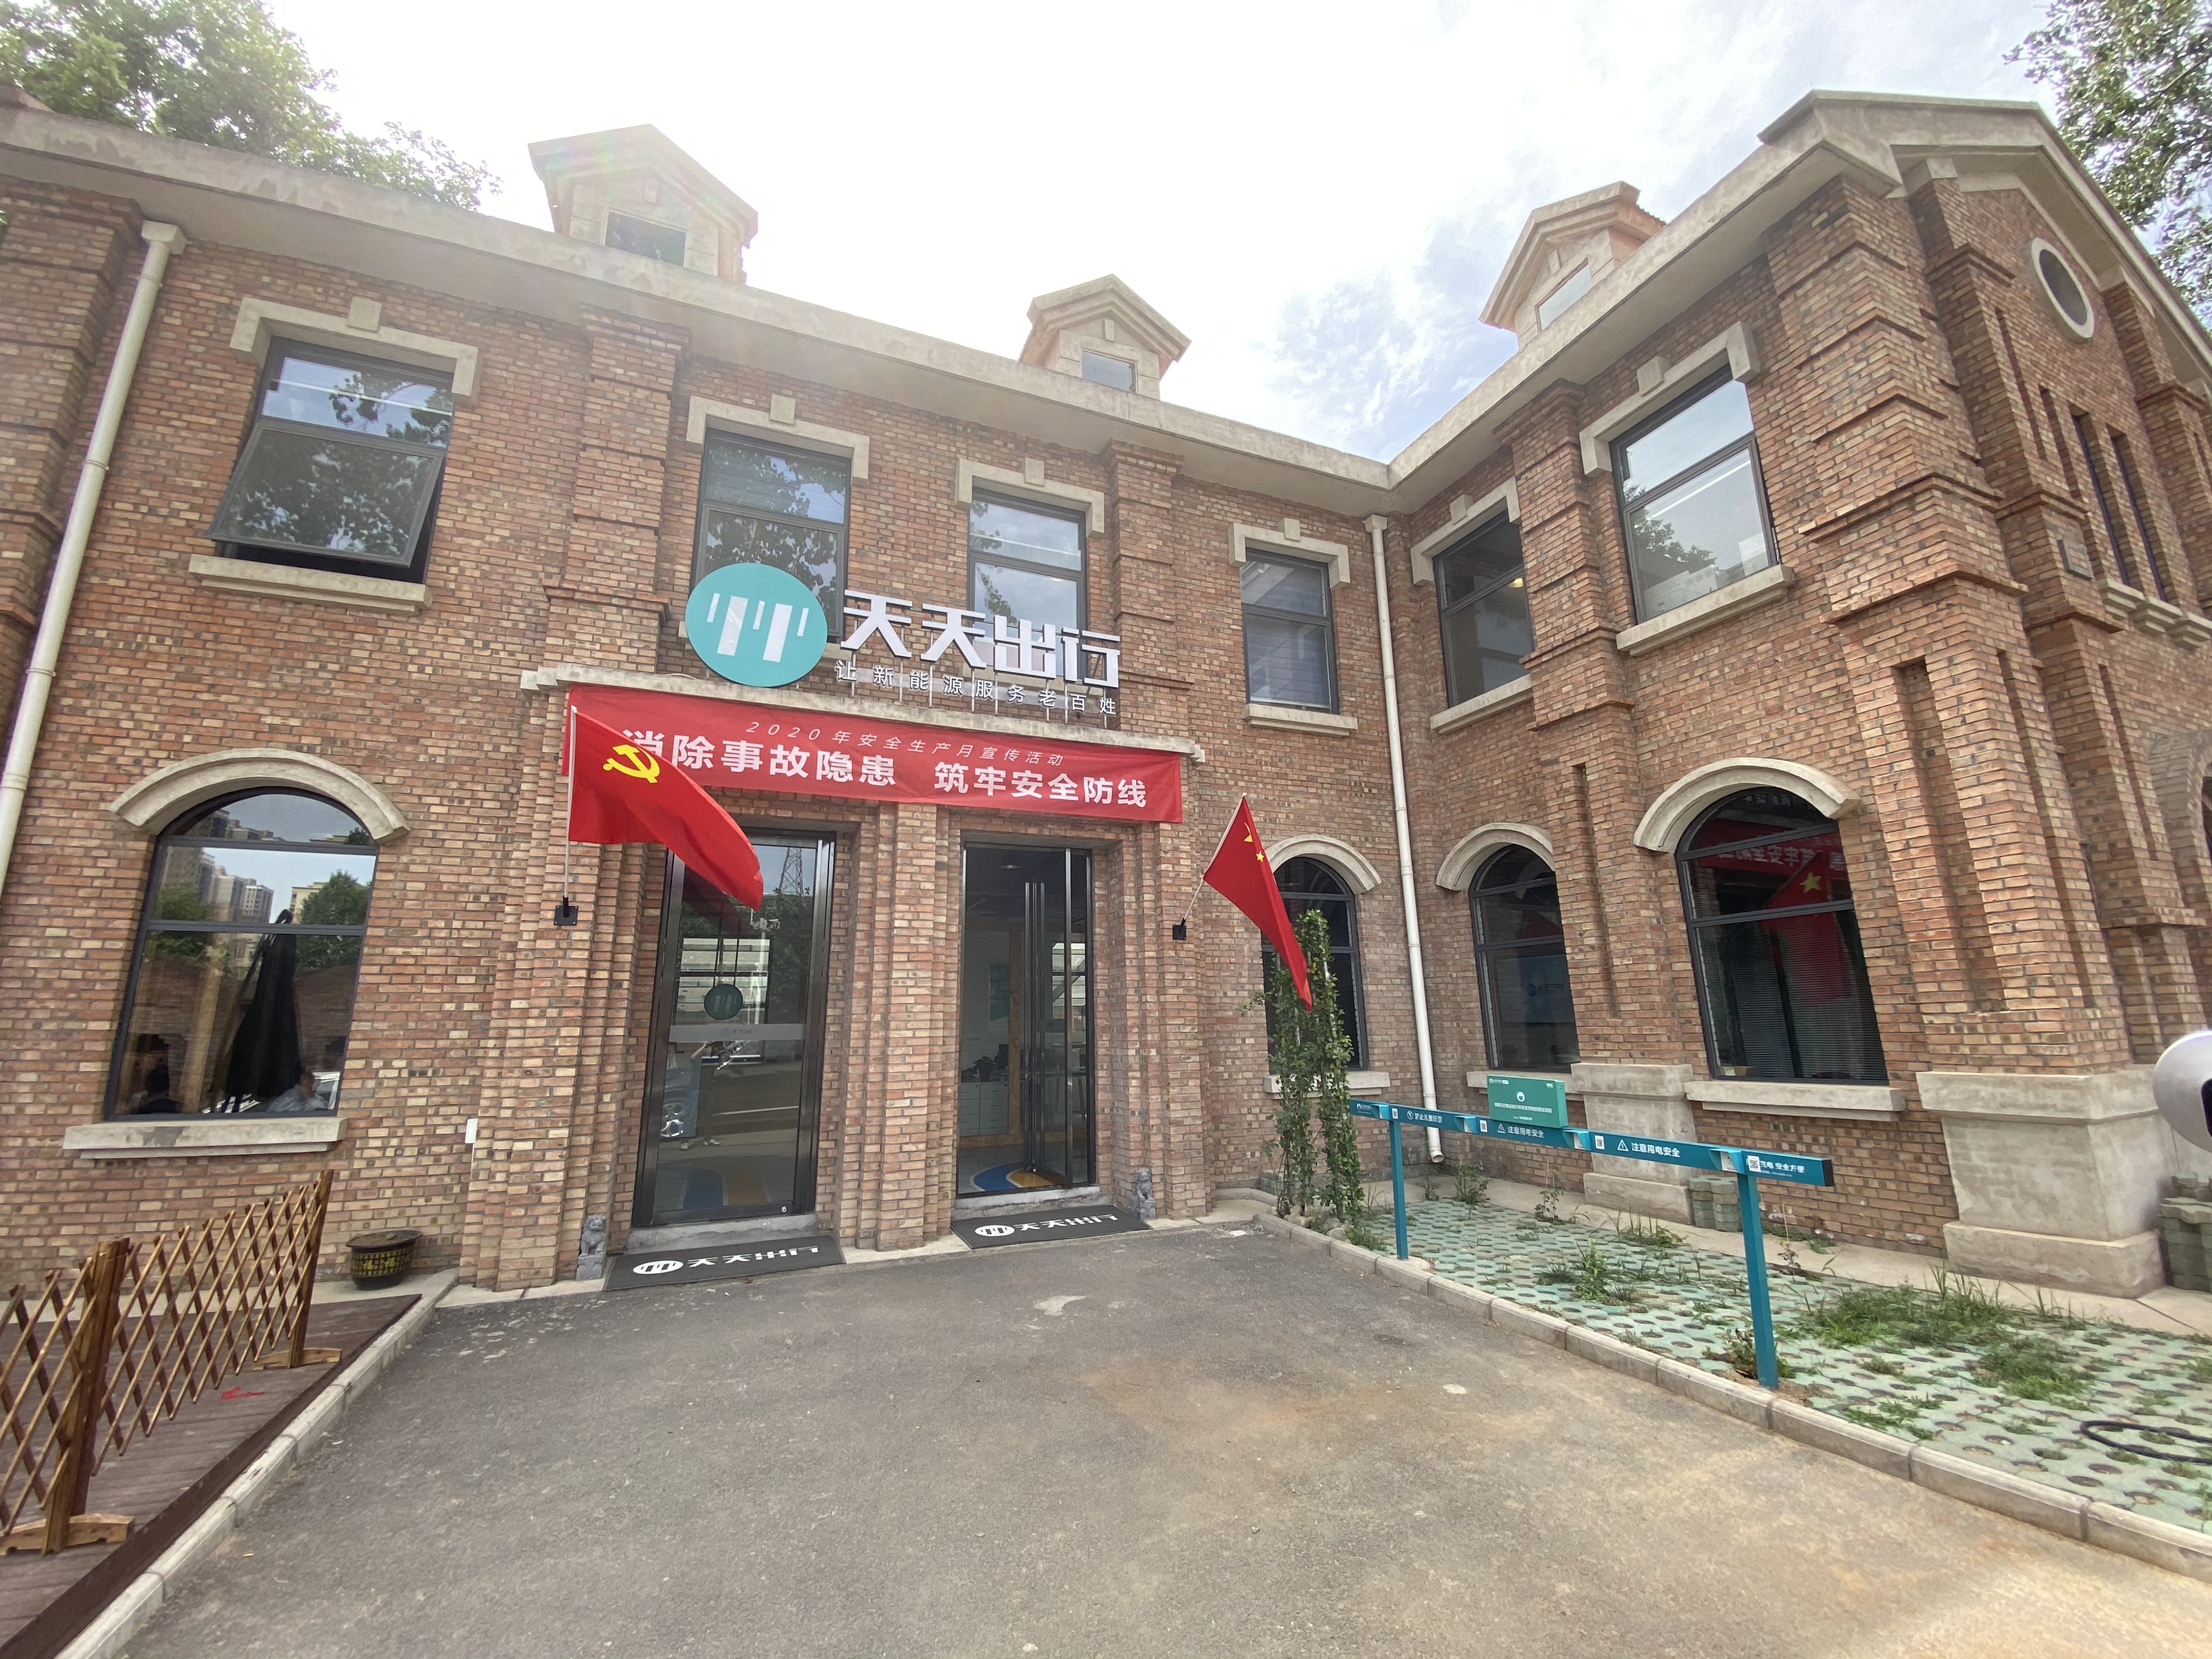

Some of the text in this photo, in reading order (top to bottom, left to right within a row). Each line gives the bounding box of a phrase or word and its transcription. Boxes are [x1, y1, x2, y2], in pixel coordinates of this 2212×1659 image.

[840, 589, 1120, 688] 天天出行
[836, 659, 1116, 716] 让新能源服务老百姓
[746, 721, 1064, 767] 2020年安全生产月宣传活动
[933, 761, 1148, 809] 筑牢安全防线
[1508, 1126, 1544, 1138] 注意用电安全
[1631, 1142, 1680, 1158] 注意用电安全
